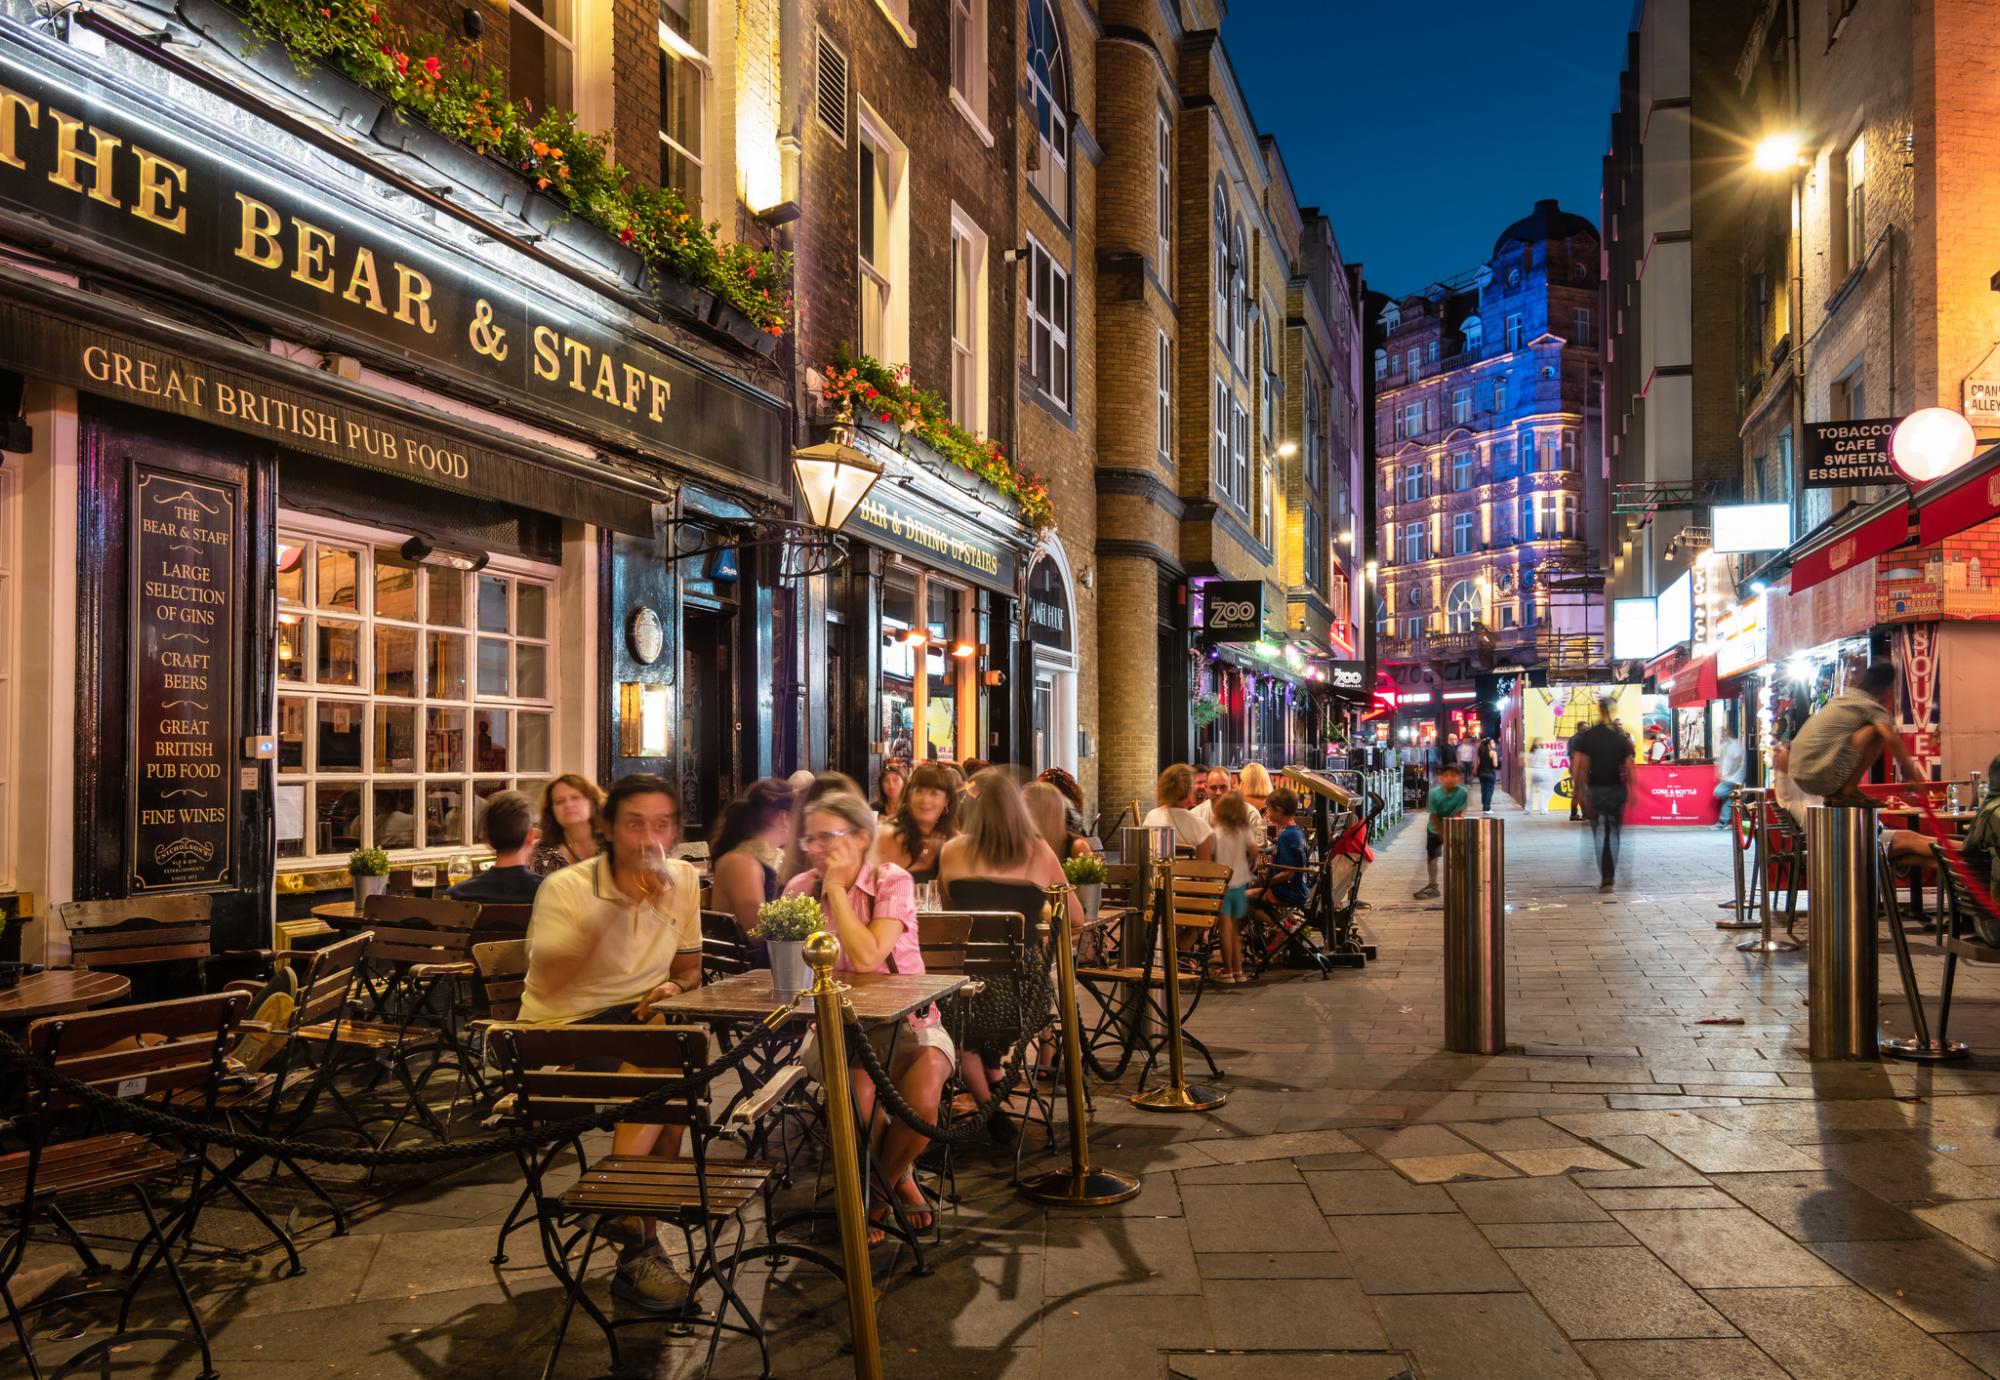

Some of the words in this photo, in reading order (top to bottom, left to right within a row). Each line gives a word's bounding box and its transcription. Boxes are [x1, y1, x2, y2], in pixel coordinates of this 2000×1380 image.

[0, 86, 188, 235] THE
[234, 191, 438, 335] BEAR
[468, 298, 509, 362] &
[533, 325, 672, 424] STAFF
[1971, 384, 2000, 397] CRAN
[82, 346, 205, 407] GREAT
[215, 382, 339, 445] BRITISH
[346, 421, 398, 460] PUB
[403, 438, 469, 480] FOOD
[1817, 424, 1893, 439] TOBACCO
[1835, 439, 1876, 452] CAFE
[1824, 451, 1887, 465] SWEETS
[1808, 465, 1896, 480] ESSENTIAL
[174, 506, 200, 522] THE
[143, 518, 177, 537] BEAR
[179, 526, 191, 539] &
[192, 527, 229, 545] STAFF
[860, 497, 888, 530] BAR
[891, 510, 902, 536] &
[905, 515, 948, 555] DINING
[951, 536, 998, 576] UPSTAIRS
[162, 561, 211, 583] LARGE
[145, 581, 225, 605] SELECTION
[156, 605, 177, 620] OF
[180, 608, 215, 625] GINS
[161, 651, 211, 669] CRAFT
[164, 673, 208, 690] BEERS
[159, 719, 210, 735] GREAT
[155, 741, 213, 757] BRITISH
[146, 763, 176, 779] PUB
[179, 763, 221, 779] FOOD
[1549, 758, 1569, 768] LA
[142, 809, 175, 825] FINE
[179, 807, 225, 823] WINES
